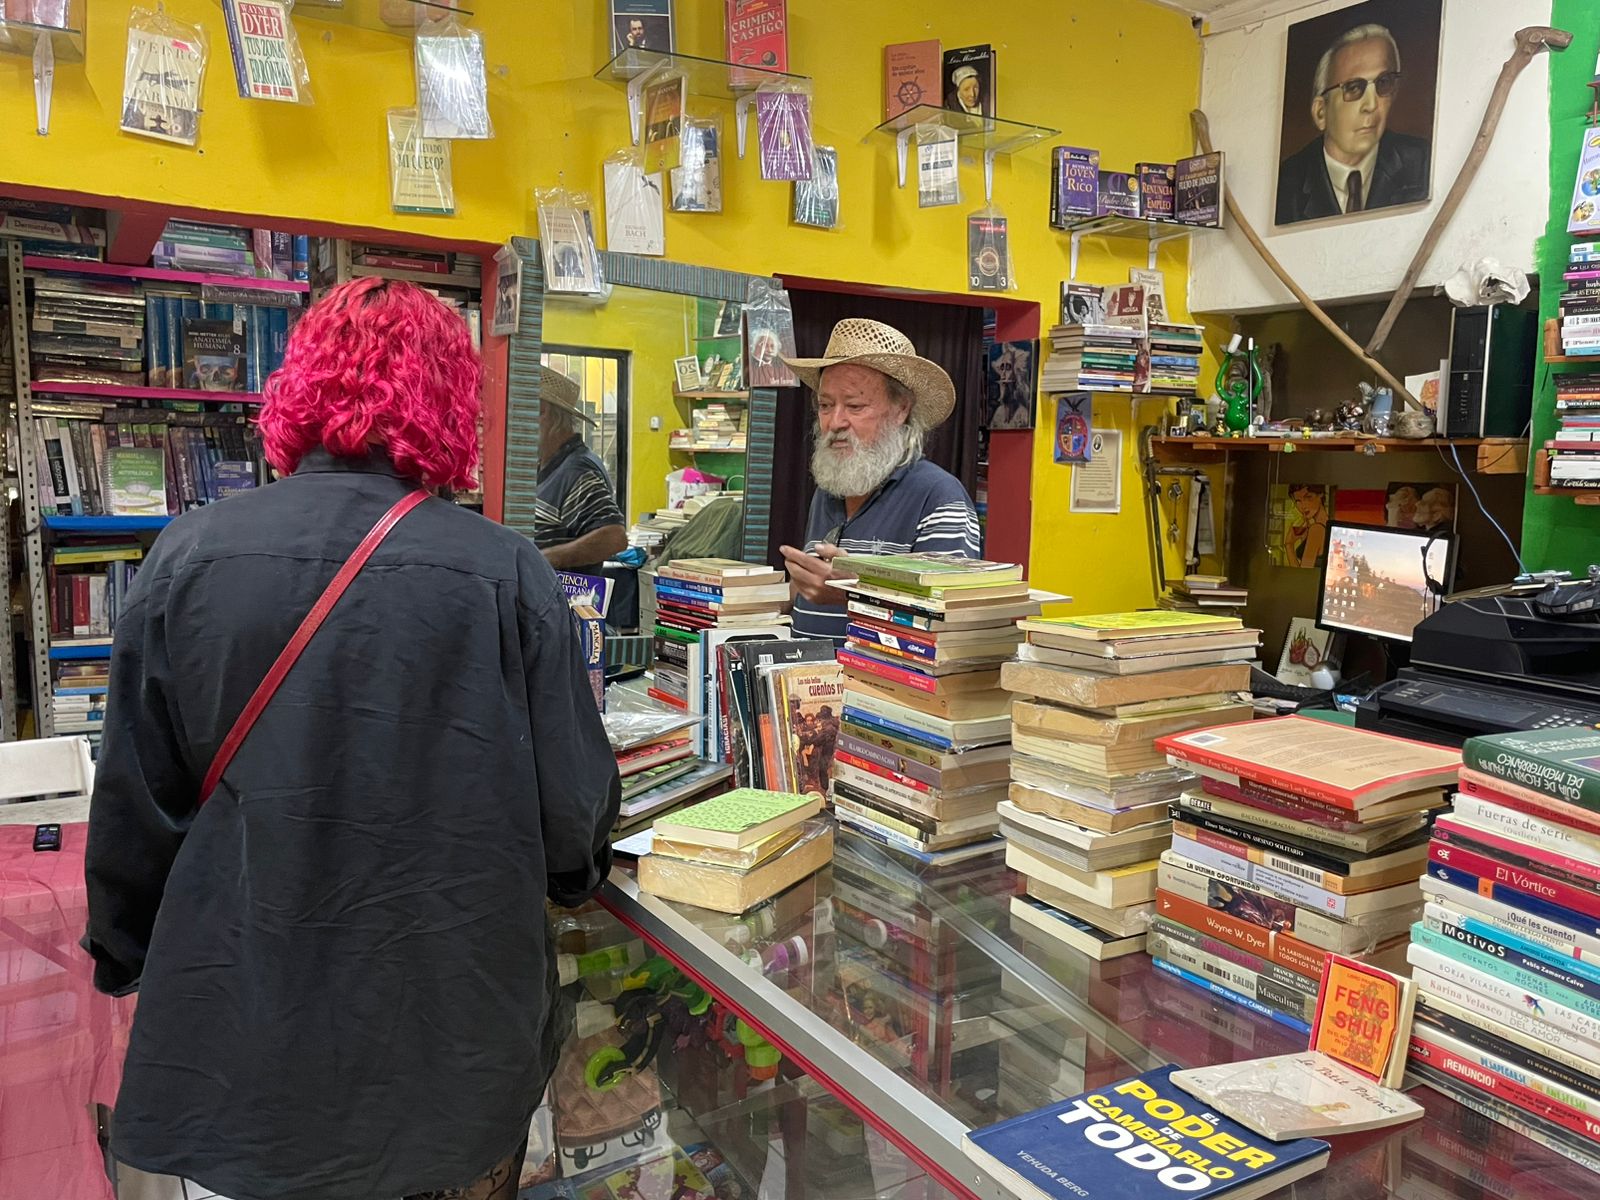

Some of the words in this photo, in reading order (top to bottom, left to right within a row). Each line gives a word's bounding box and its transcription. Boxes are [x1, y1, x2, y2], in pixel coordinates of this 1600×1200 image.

[242, 13, 282, 37] DYER
[731, 10, 775, 32] CRIMEN
[731, 20, 784, 43] CASTIGO
[245, 37, 260, 55] TUS
[1064, 163, 1095, 179] JOVEN
[1067, 178, 1093, 192] RICO
[1147, 198, 1171, 209] EMPLEO
[1000, 276, 1006, 287] 3
[193, 342, 227, 350] HUMANA
[233, 344, 241, 355] 8
[592, 624, 600, 660] MANCALA
[809, 682, 836, 697] cuentos
[1234, 767, 1257, 779] Personal
[1507, 767, 1514, 778] Y
[1515, 769, 1541, 788] FLORA
[1567, 773, 1585, 789] DEL
[1545, 779, 1557, 793] DE
[1191, 799, 1211, 810] DEBATE
[1477, 805, 1518, 826] Fueras
[1522, 818, 1537, 832] de
[1541, 826, 1573, 842] serie
[1252, 836, 1274, 847] ASESINO
[1275, 843, 1304, 857] SOLITARIO
[1186, 862, 1193, 870] LA
[1194, 866, 1215, 877] ULTIMA
[1216, 872, 1260, 891] OPORTUNIDAD
[1496, 867, 1508, 881] El
[1511, 871, 1557, 898] Vórtice
[1206, 917, 1233, 935] Wayne
[1235, 928, 1245, 941] W.
[1246, 933, 1266, 949] Dyer
[1507, 912, 1527, 925] ¡Qué
[1528, 919, 1541, 930] les
[1542, 926, 1576, 943] cuento!
[1444, 924, 1505, 957] MotivoS
[1278, 945, 1286, 953] LA
[1287, 948, 1316, 964] SABIDURÍA
[1279, 951, 1298, 964] TODOS
[1298, 960, 1309, 969] LOS
[1462, 952, 1499, 972] CUENTOS
[1232, 974, 1255, 991] SALUD
[1273, 967, 1294, 978] FRANCIS
[1297, 974, 1310, 985] KING
[1273, 972, 1294, 985] STEPHEN
[1439, 963, 1465, 980] BORJA
[1469, 975, 1511, 999] VILASECA
[1516, 971, 1548, 988] BUENAS
[1522, 958, 1540, 971] Pablo
[1541, 966, 1565, 981] Zamora
[1566, 976, 1585, 988] Calvo
[1515, 977, 1549, 995] NOCHES
[1258, 985, 1299, 1011] Masculina
[1335, 984, 1389, 1020] FENG
[1429, 979, 1462, 1000] Karina
[1466, 993, 1502, 1016] Velasco
[1555, 1007, 1572, 1019] LAS
[1334, 1010, 1382, 1044] SHUI
[1509, 1017, 1527, 1032] DEL
[1530, 1027, 1561, 1044] AMOR
[1511, 1009, 1529, 1023] LOS
[1531, 1017, 1578, 1043] COLORES
[1571, 1023, 1587, 1035] NO
[1543, 1047, 1583, 1072] Muchacha
[1443, 1058, 1496, 1089] ¡RENUNCIO!
[1295, 1057, 1315, 1068] Le
[1316, 1066, 1350, 1086] Petit
[1351, 1085, 1399, 1115] Prince
[1113, 1080, 1277, 1169] PODER
[1200, 1112, 1222, 1126] EL
[1086, 1094, 1235, 1179] CAMBIARLO
[1159, 1126, 1184, 1141] DE
[1057, 1100, 1212, 1191] TODO
[1016, 1150, 1058, 1179] YEHUDA
[1056, 1176, 1090, 1198] BERG
